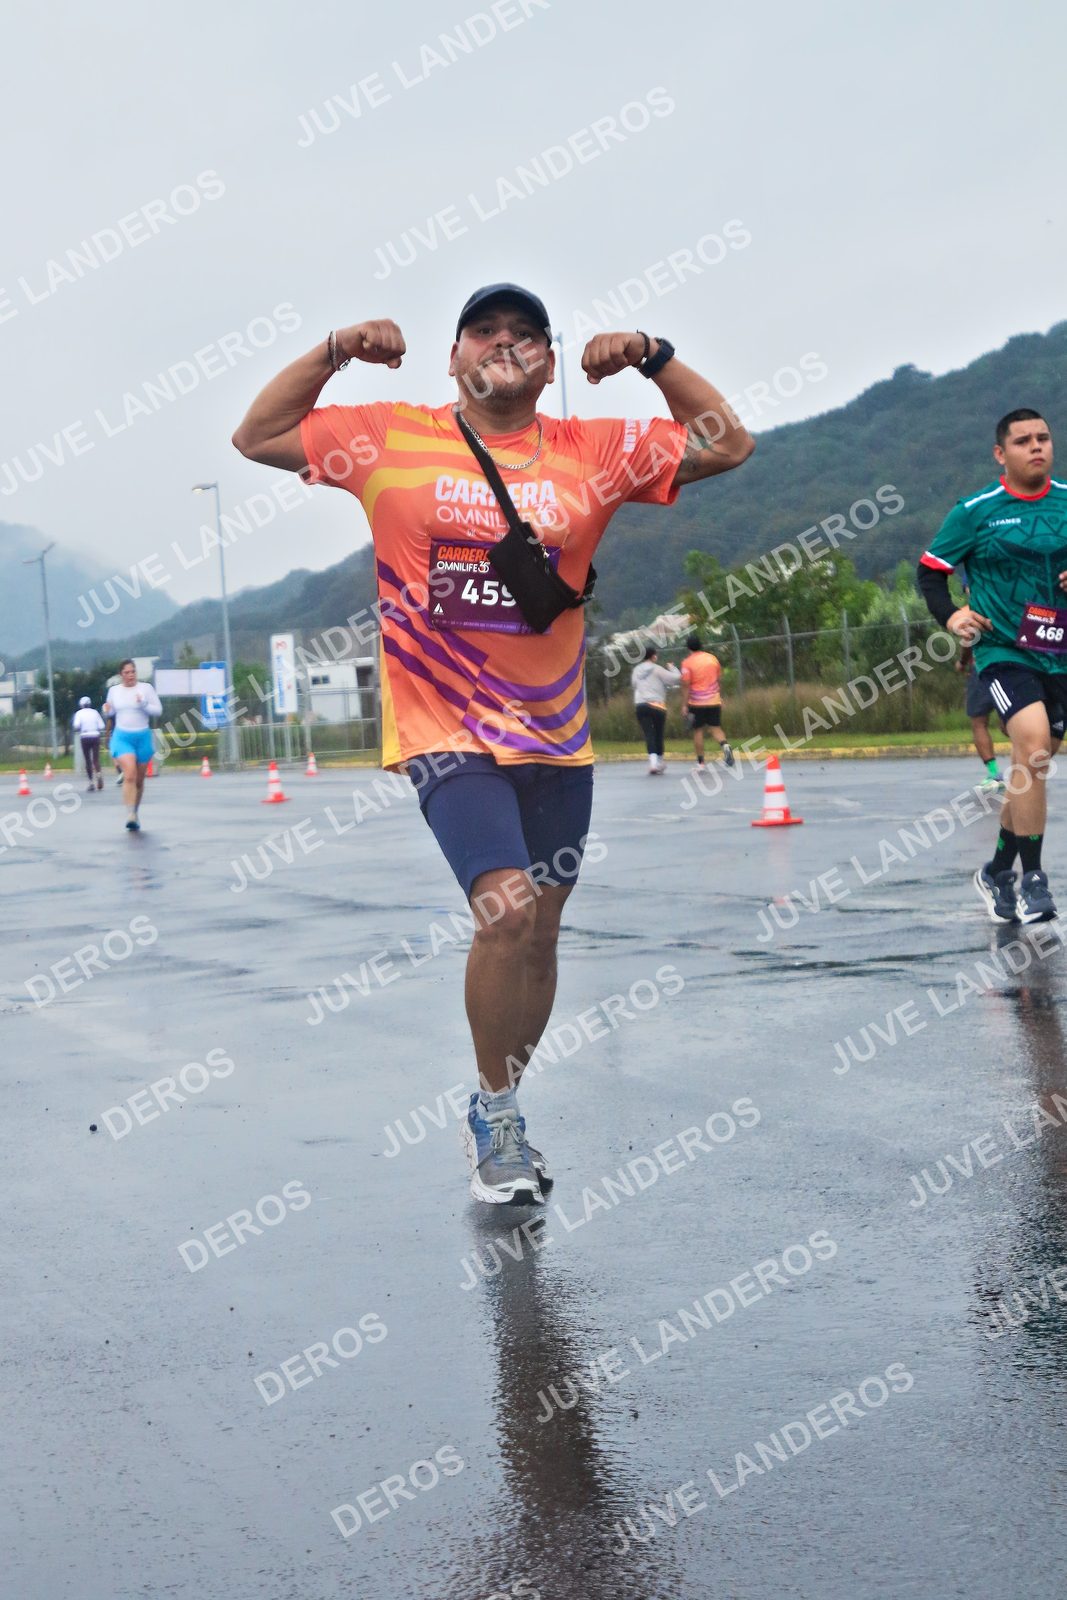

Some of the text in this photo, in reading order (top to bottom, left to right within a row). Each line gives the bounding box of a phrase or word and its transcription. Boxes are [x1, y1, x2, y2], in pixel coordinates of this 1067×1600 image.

[436, 505, 531, 529] OMNILE
[437, 561, 478, 572] OMNILIFE
[1036, 625, 1064, 642] 468
